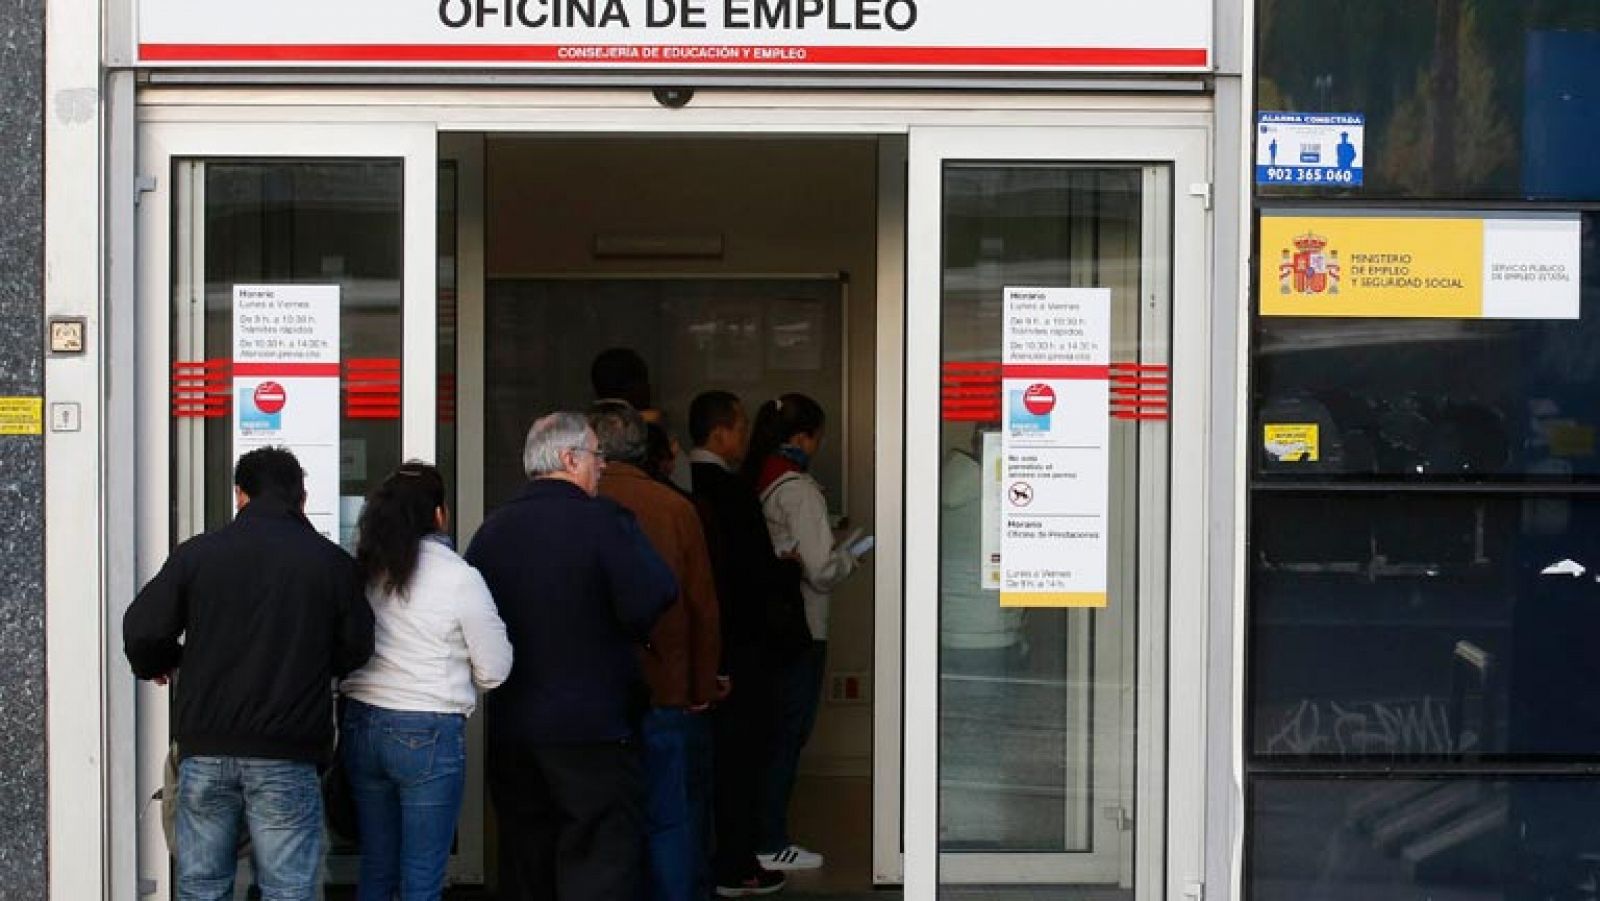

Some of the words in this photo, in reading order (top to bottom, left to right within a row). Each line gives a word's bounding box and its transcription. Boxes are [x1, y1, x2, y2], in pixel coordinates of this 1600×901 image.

[438, 0, 630, 28] OFICINA
[645, 0, 707, 28] DE
[723, 0, 918, 30] EMPLEO
[558, 46, 638, 58] CONSEJERÍA
[643, 47, 659, 58] DE
[663, 46, 739, 58] EDUCACIÓN
[743, 48, 751, 58] Y
[753, 48, 806, 59] EMPLEO
[1303, 116, 1361, 124] CONECTADA
[1267, 168, 1292, 180] 902
[1296, 169, 1321, 180] 365
[1326, 170, 1351, 181] 060
[1351, 254, 1412, 263] MINISTERIO
[1351, 266, 1364, 275] DE
[1368, 266, 1409, 275] EMPLEO
[1351, 278, 1357, 287] Y
[1361, 278, 1422, 288] SEGURIDAD
[1425, 278, 1464, 288] SOCIAL
[239, 290, 275, 298] Horario
[1010, 292, 1046, 300] Horario
[239, 300, 266, 308] Lunes
[1008, 520, 1042, 528] Horario
